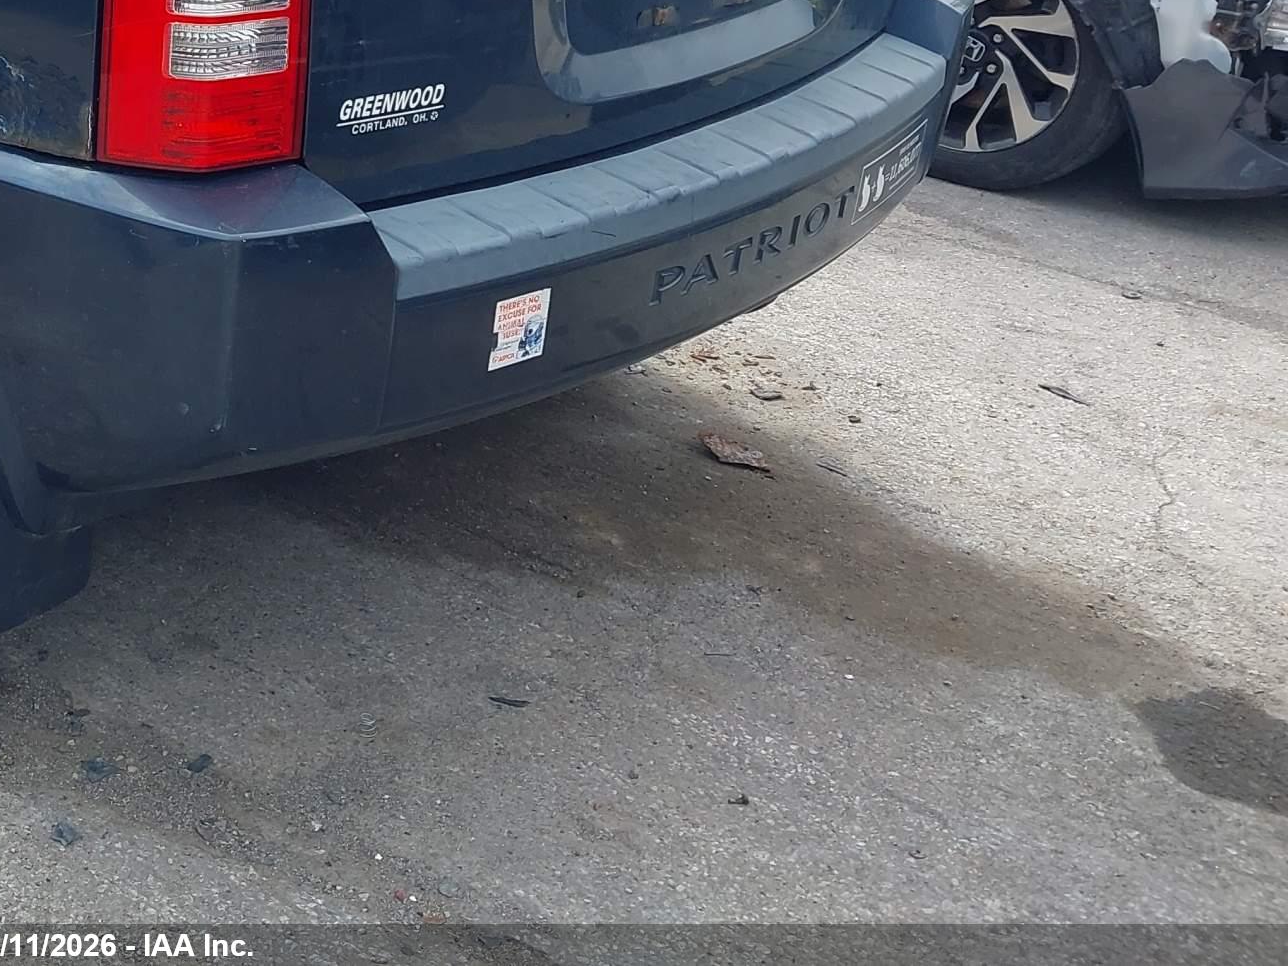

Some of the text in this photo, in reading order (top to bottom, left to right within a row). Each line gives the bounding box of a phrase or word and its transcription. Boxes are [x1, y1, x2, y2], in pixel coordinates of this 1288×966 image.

[339, 83, 445, 121] GREENWOOD
[648, 185, 856, 306] PATRIOT
[498, 303, 542, 323] EXCUSE FOR
[499, 295, 540, 313] THERE'S NO
